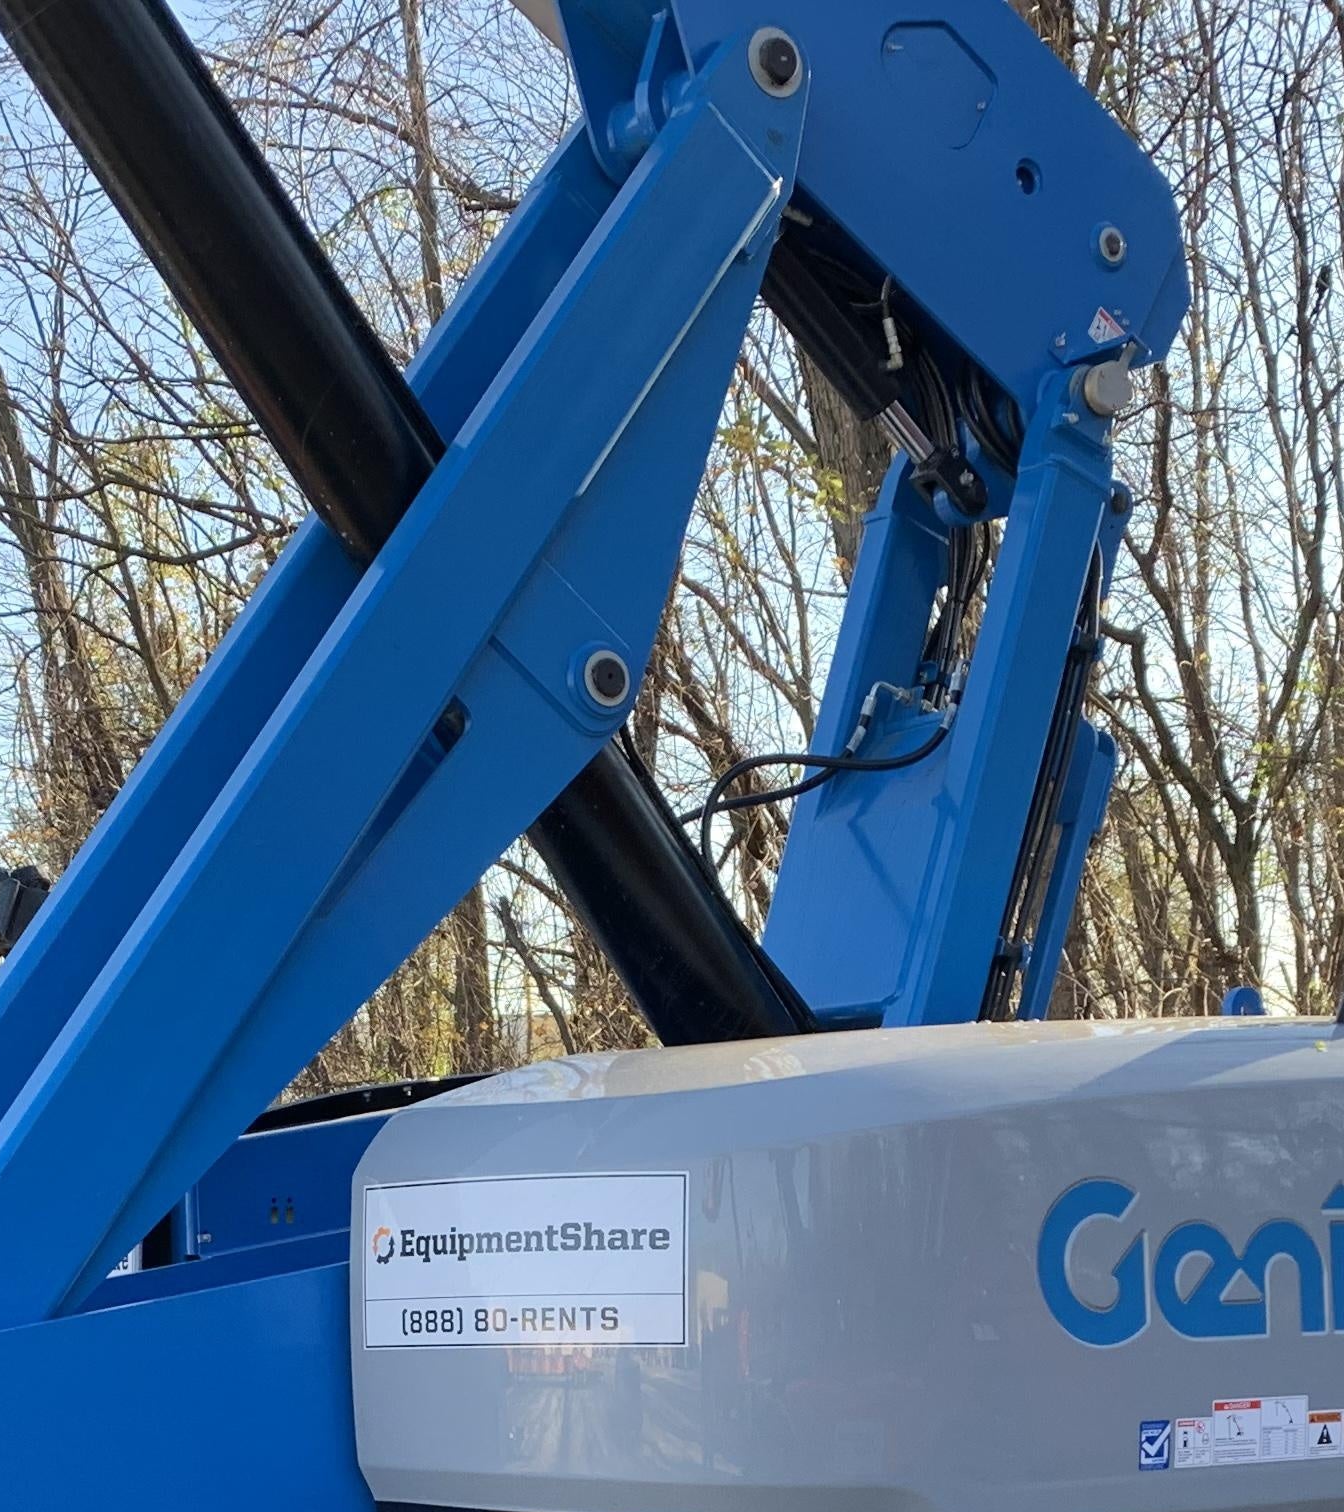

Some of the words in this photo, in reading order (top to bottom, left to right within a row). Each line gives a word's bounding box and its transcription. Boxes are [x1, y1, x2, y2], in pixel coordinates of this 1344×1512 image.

[399, 1221, 671, 1264] EquipmentShare
[401, 1307, 464, 1336] (888)
[473, 1305, 620, 1333] 80-RENTS
